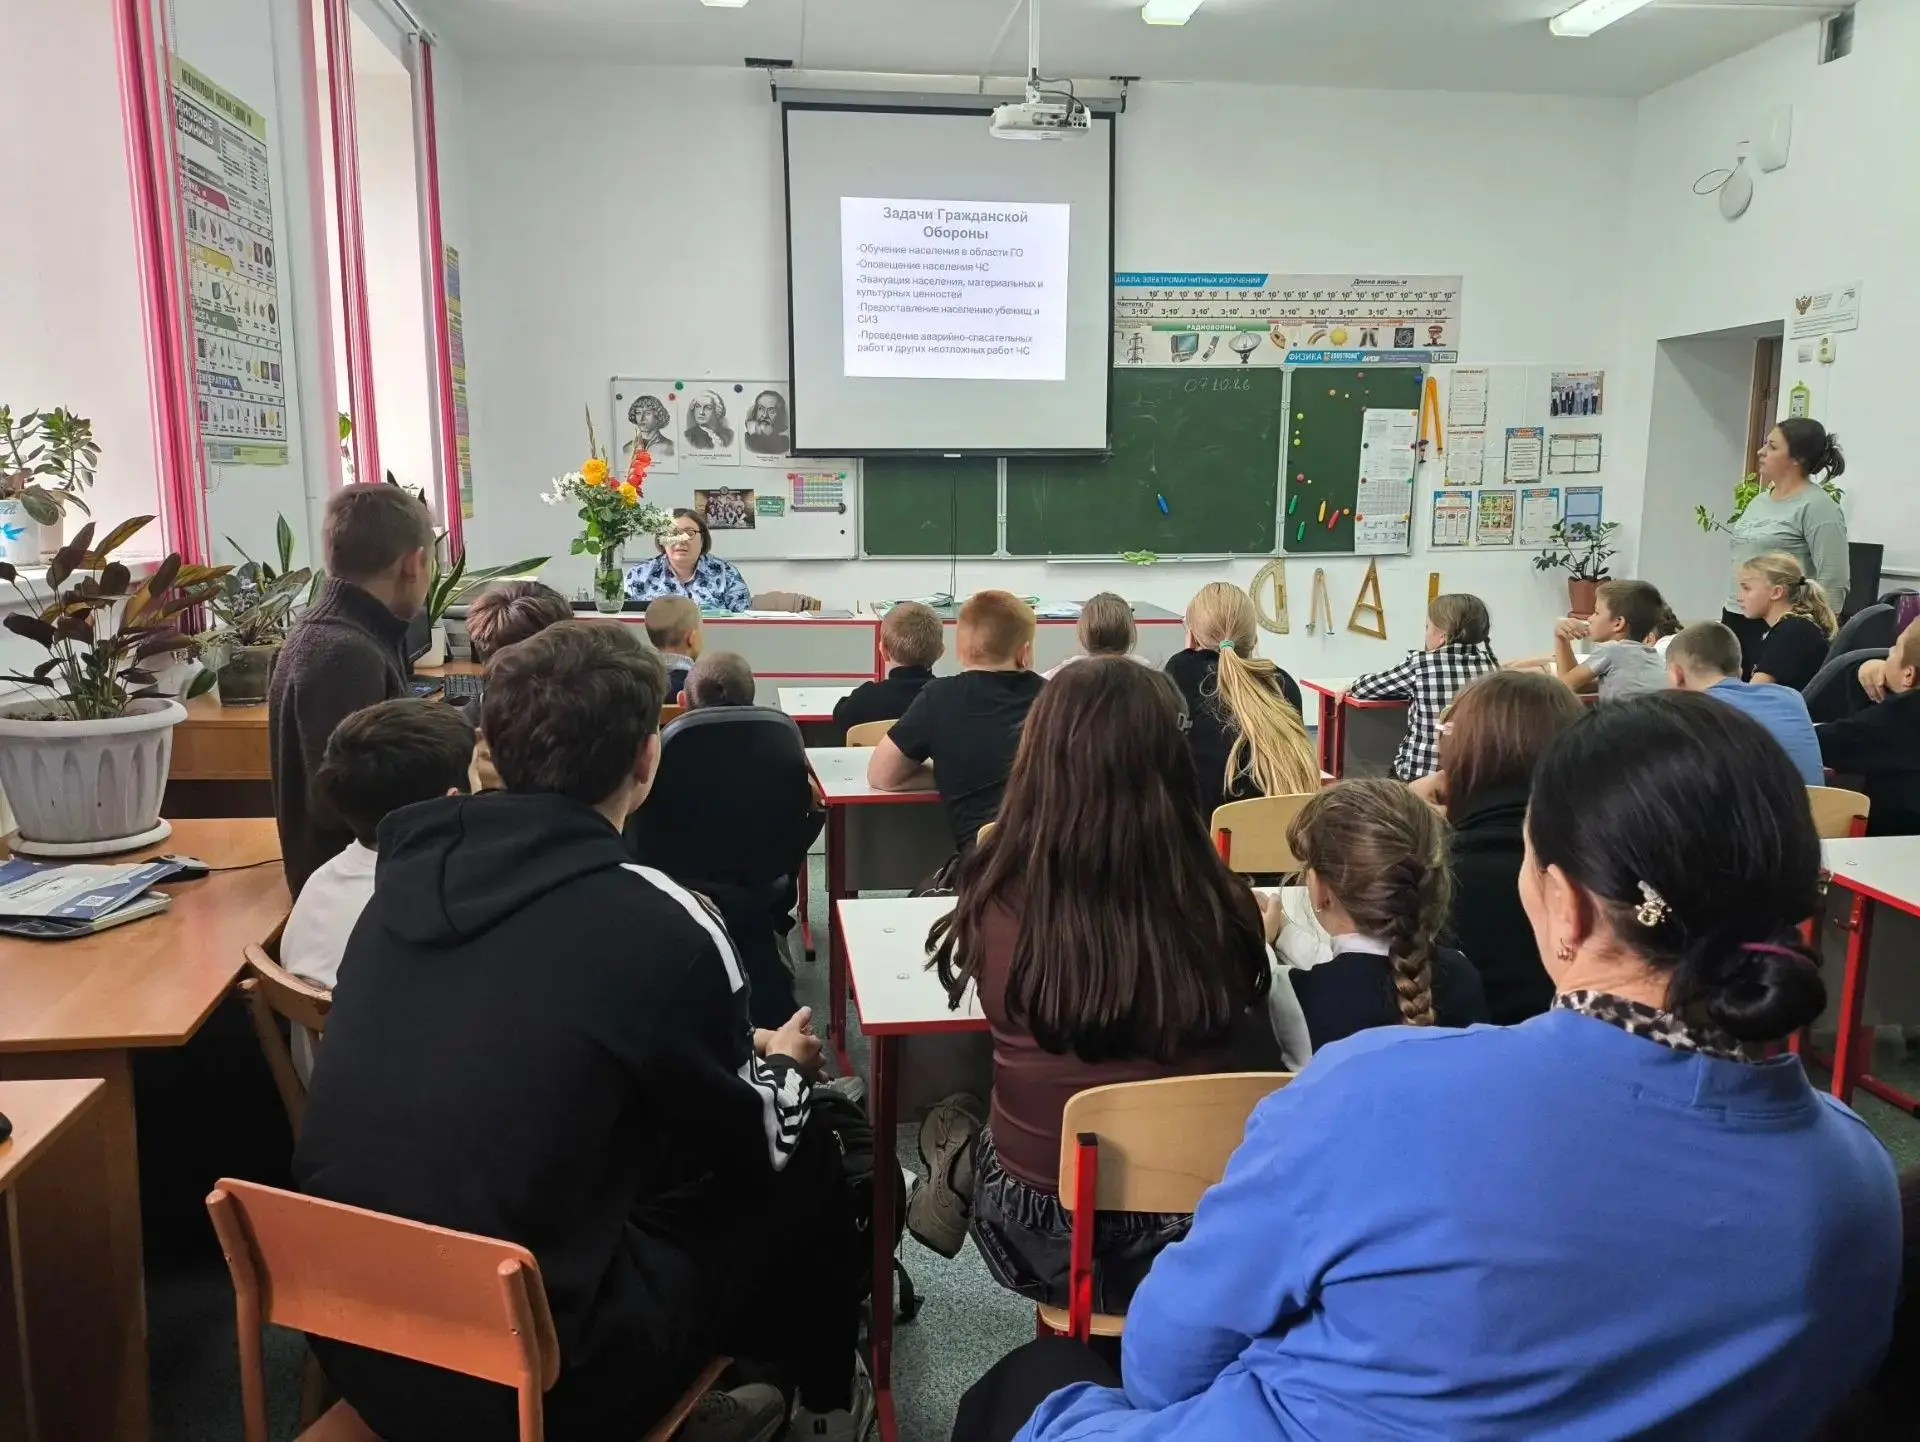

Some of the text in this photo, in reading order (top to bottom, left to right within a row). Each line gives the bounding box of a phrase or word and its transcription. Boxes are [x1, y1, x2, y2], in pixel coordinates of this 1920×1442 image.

[883, 206, 1028, 223] Задачи Гражданской
[923, 225, 989, 240] Обороны
[908, 247, 960, 257] населения
[969, 247, 1008, 258] области
[1010, 248, 1024, 257] ГО
[856, 259, 990, 272] -Оповещение населения ЧС
[856, 275, 1044, 289] -Эвакуация населения, материальных и
[1142, 276, 1218, 284] ЭЛЕКТРОМАГНИТНЫХ
[856, 289, 962, 299] культурных ценностей
[940, 305, 993, 314] населению
[994, 305, 1033, 316] убежищ
[857, 314, 878, 324] СИЗ
[920, 332, 1033, 344] аварийно-спасательных
[857, 343, 885, 354] работ
[894, 345, 928, 355] других
[928, 346, 985, 355] неотложных
[986, 346, 1014, 356] работ
[1015, 346, 1030, 355] ЧС
[1288, 353, 1322, 361] ФИЗИКА
